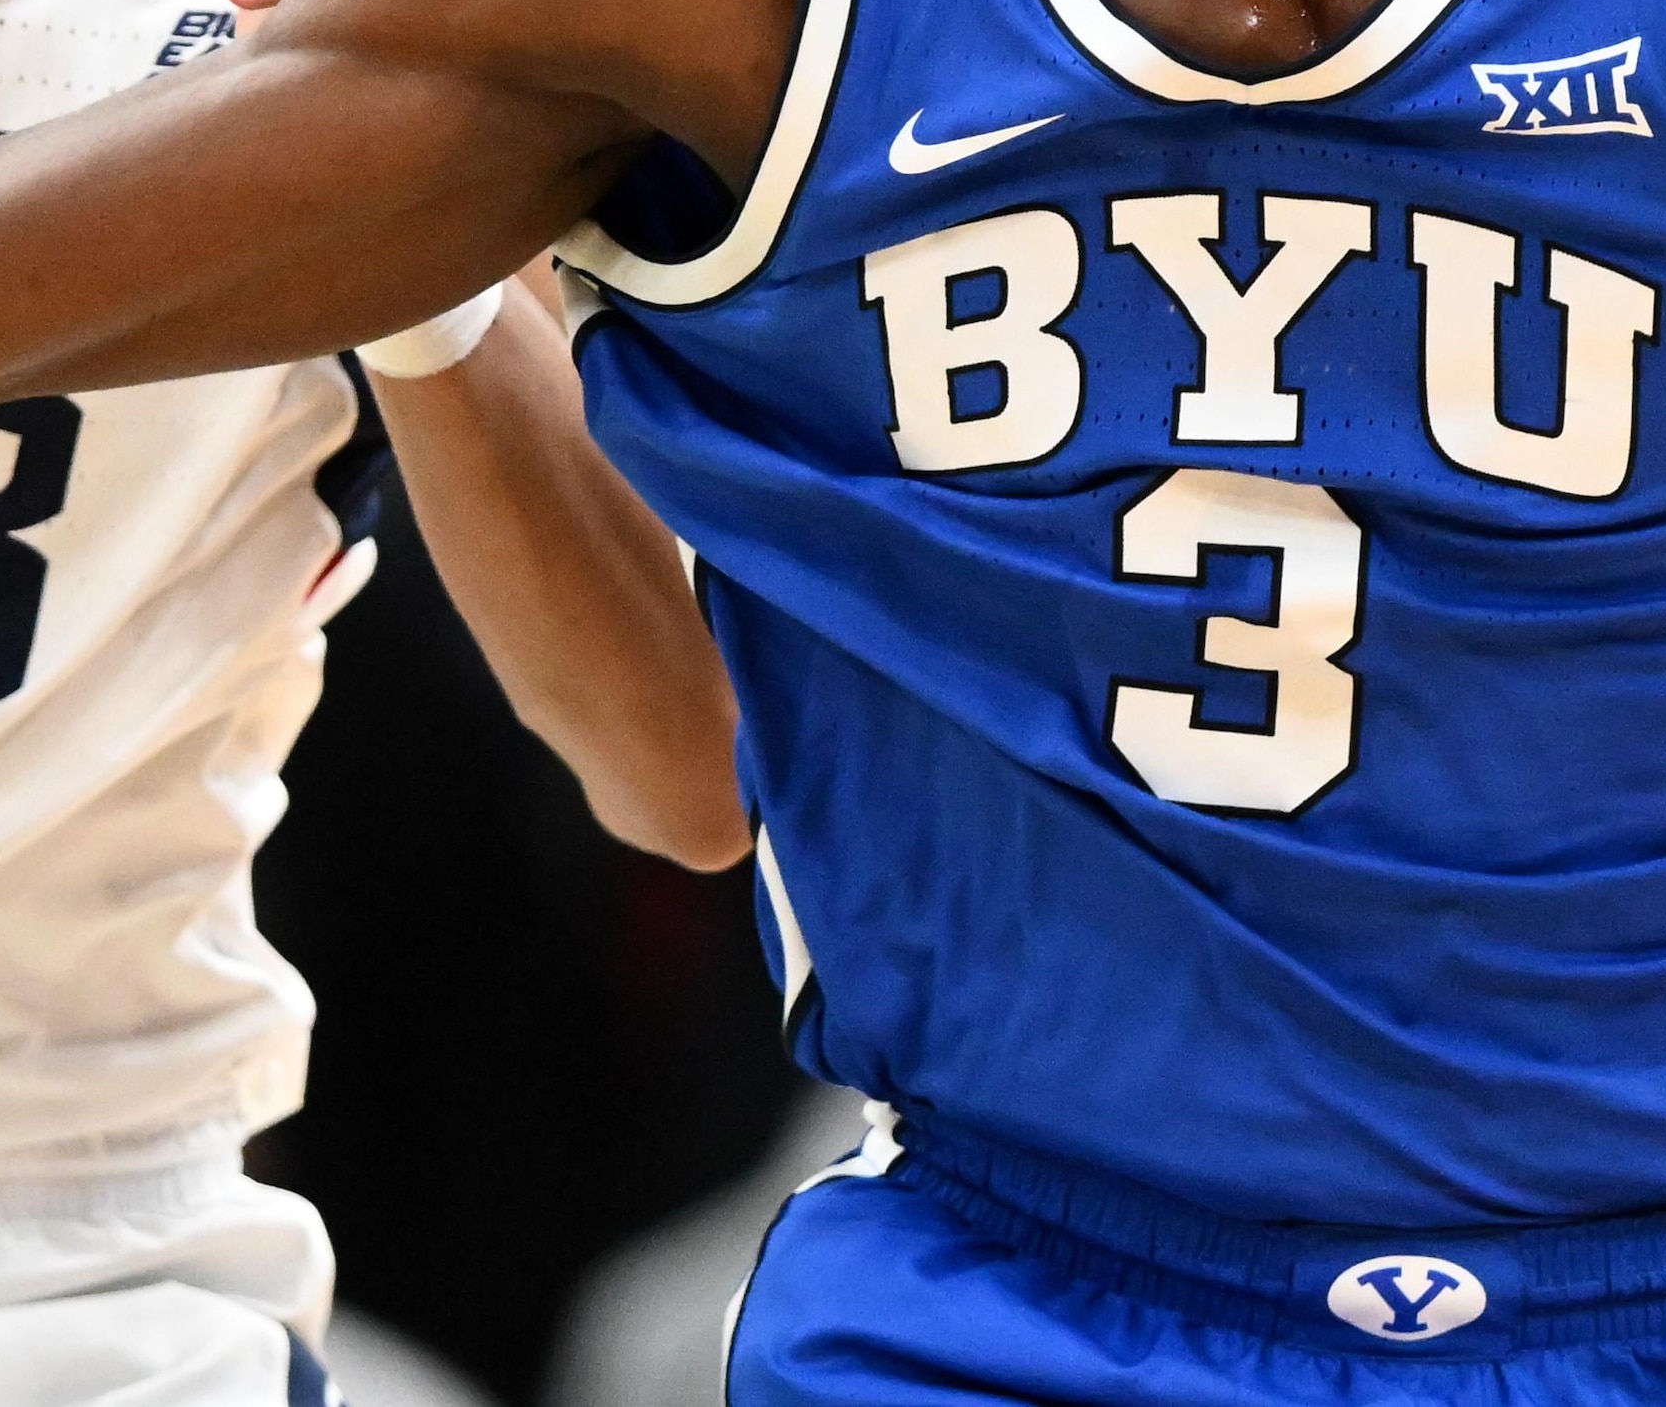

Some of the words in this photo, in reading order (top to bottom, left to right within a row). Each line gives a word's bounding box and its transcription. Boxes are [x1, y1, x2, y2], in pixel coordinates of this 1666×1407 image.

[859, 188, 1660, 500] BYU
[1106, 467, 1368, 818] 3
[1357, 1267, 1460, 1332] Y
